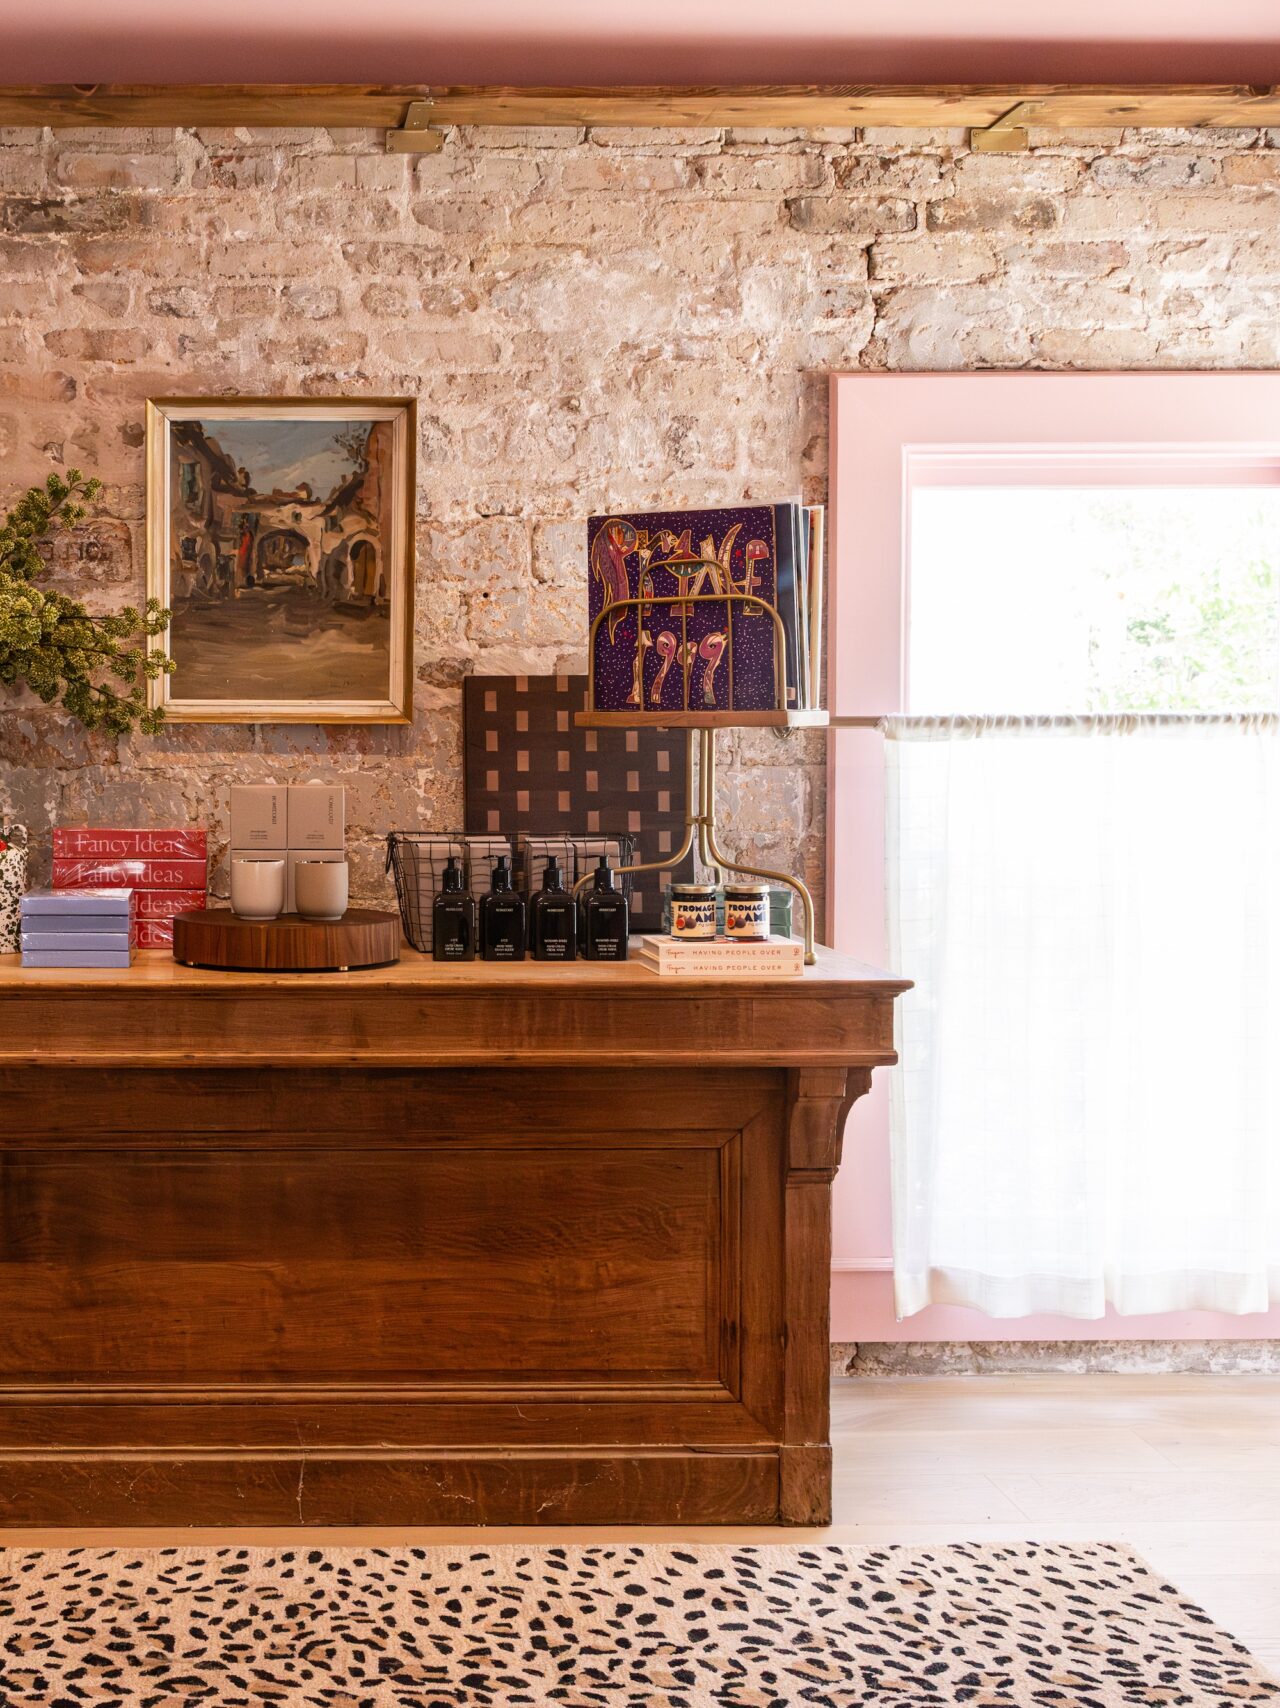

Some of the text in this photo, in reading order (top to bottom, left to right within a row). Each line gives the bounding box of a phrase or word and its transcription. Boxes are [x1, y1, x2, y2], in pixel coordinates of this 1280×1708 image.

[76, 833, 184, 856] Fancy Ideas
[134, 894, 183, 912] Ideas
[695, 912, 715, 923] AMI
